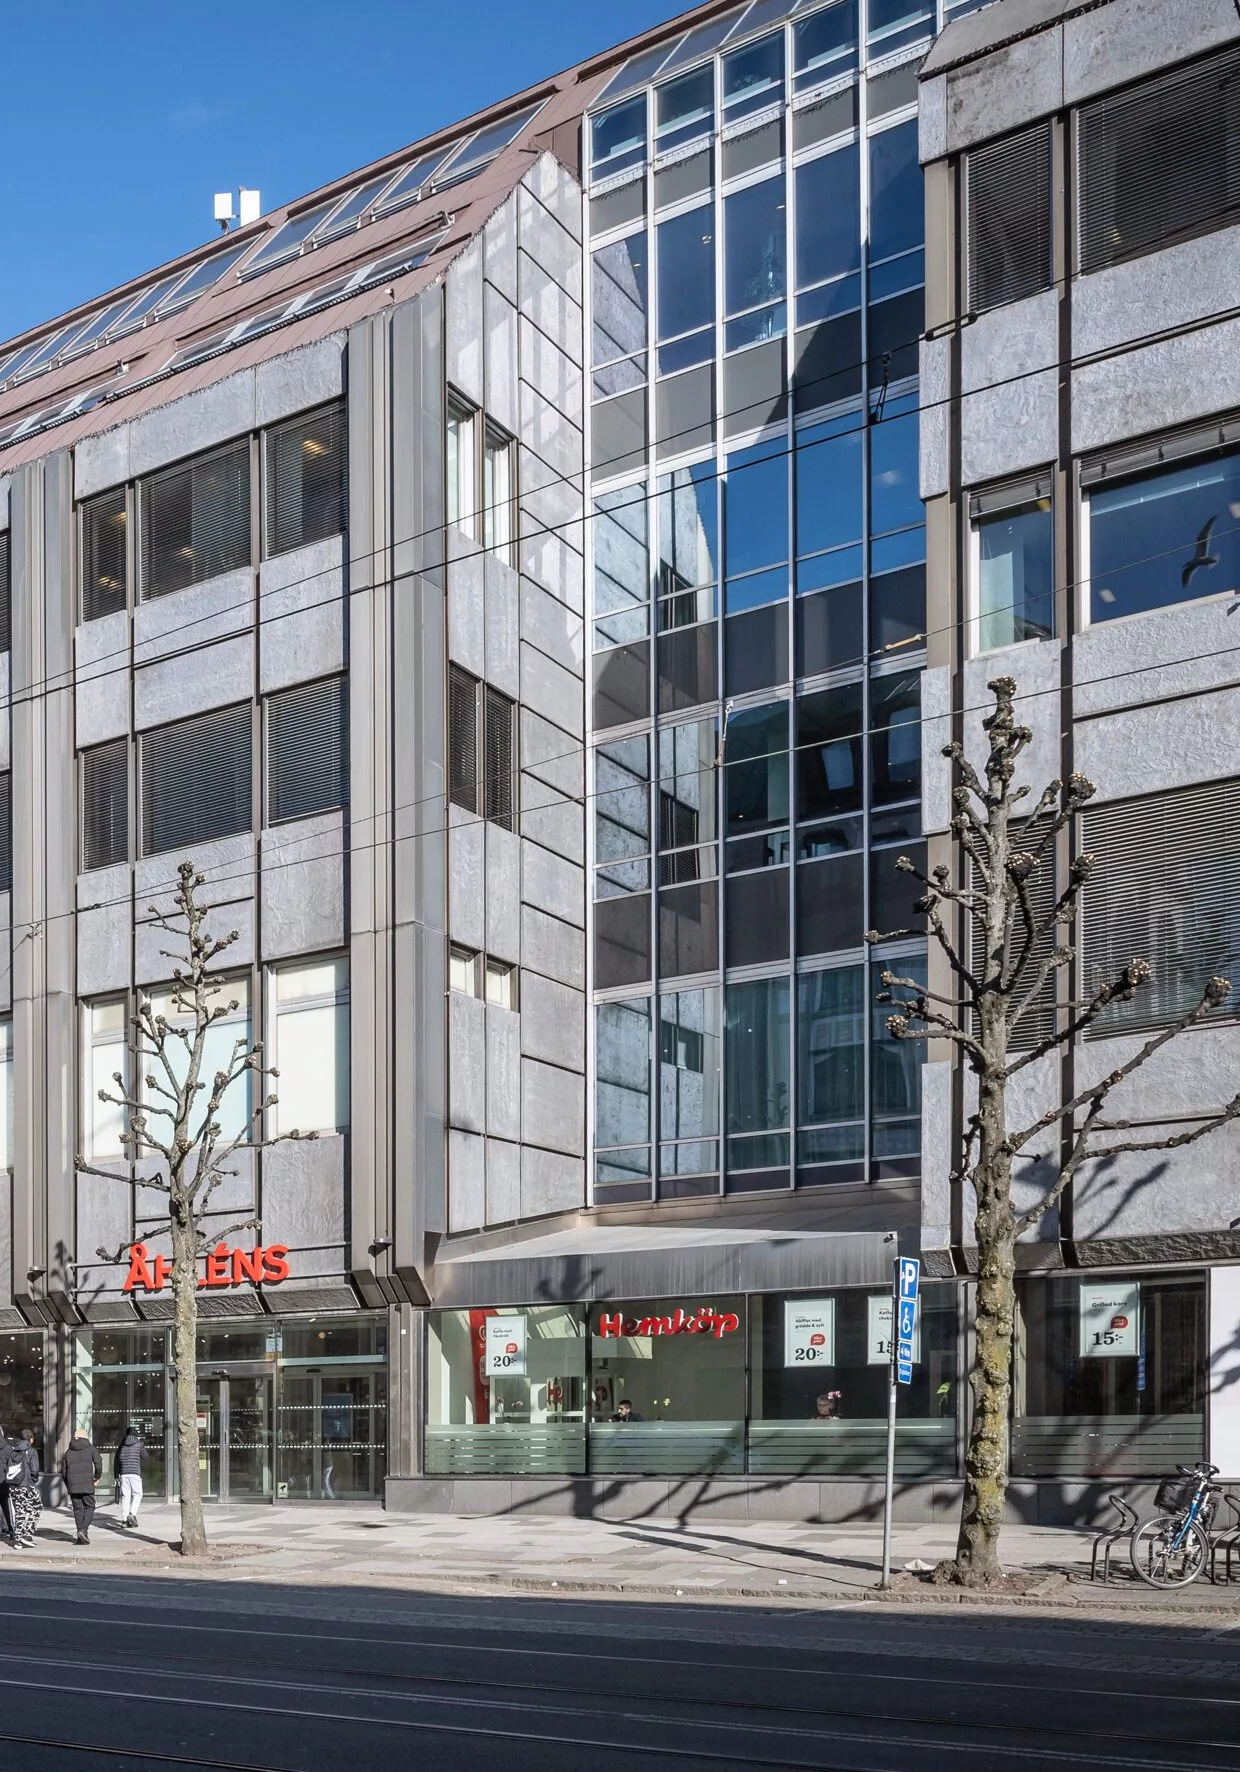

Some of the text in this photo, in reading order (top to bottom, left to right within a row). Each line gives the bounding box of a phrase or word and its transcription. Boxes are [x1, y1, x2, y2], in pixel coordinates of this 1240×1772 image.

[905, 1262, 916, 1295] P
[599, 1307, 739, 1339] Hemköp
[1092, 1331, 1123, 1346] 15:-
[493, 1355, 517, 1368] 20:-
[795, 1348, 823, 1361] 20:-
